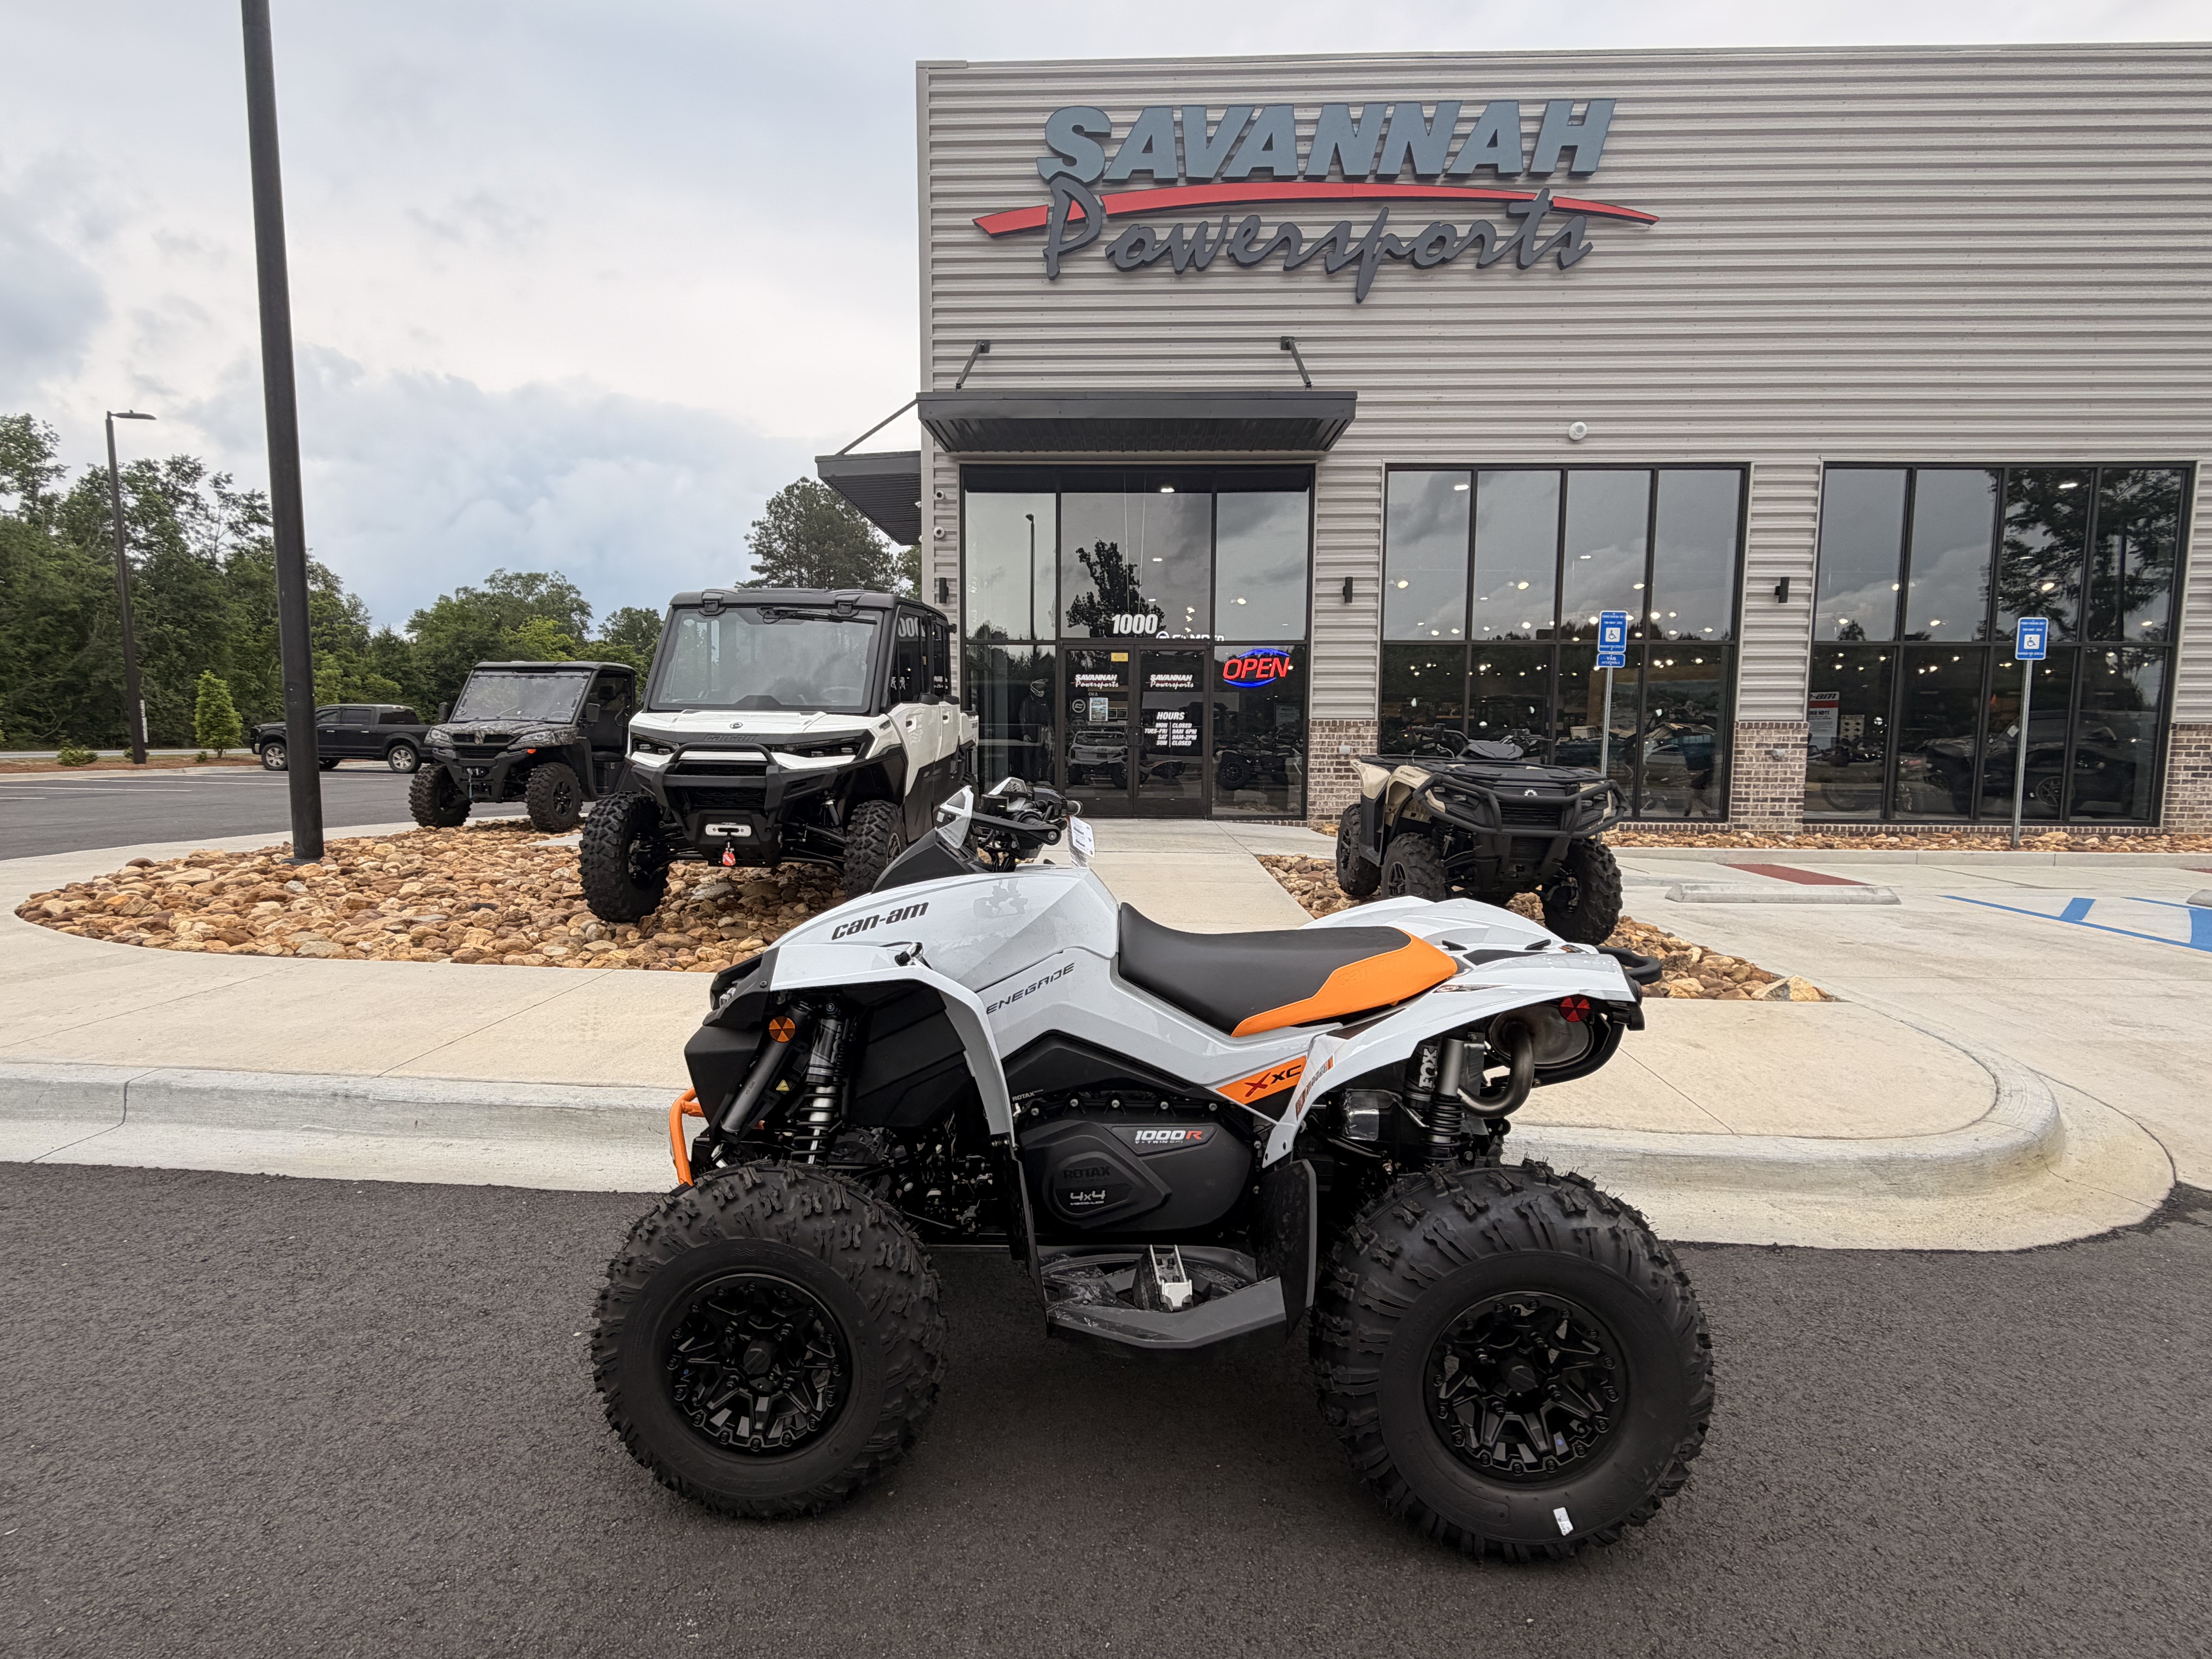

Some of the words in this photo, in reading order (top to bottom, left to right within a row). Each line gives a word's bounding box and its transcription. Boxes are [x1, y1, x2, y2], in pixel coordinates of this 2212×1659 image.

[1036, 99, 1616, 181] SAVANNAH
[1043, 177, 1594, 303] Powersports
[1112, 614, 1158, 634] 1000
[1223, 657, 1290, 679] OPEN
[1075, 678, 1119, 690] Powersports
[1150, 678, 1194, 690] Powersports
[1156, 711, 1185, 720] HOURS
[831, 902, 929, 941] can-am
[986, 962, 1075, 1015] ENEGADE
[1419, 1048, 1437, 1089] FOX
[1012, 1091, 1035, 1102] ROTAX
[1135, 1130, 1202, 1140] 1000R
[1063, 1166, 1111, 1178] ROTAX
